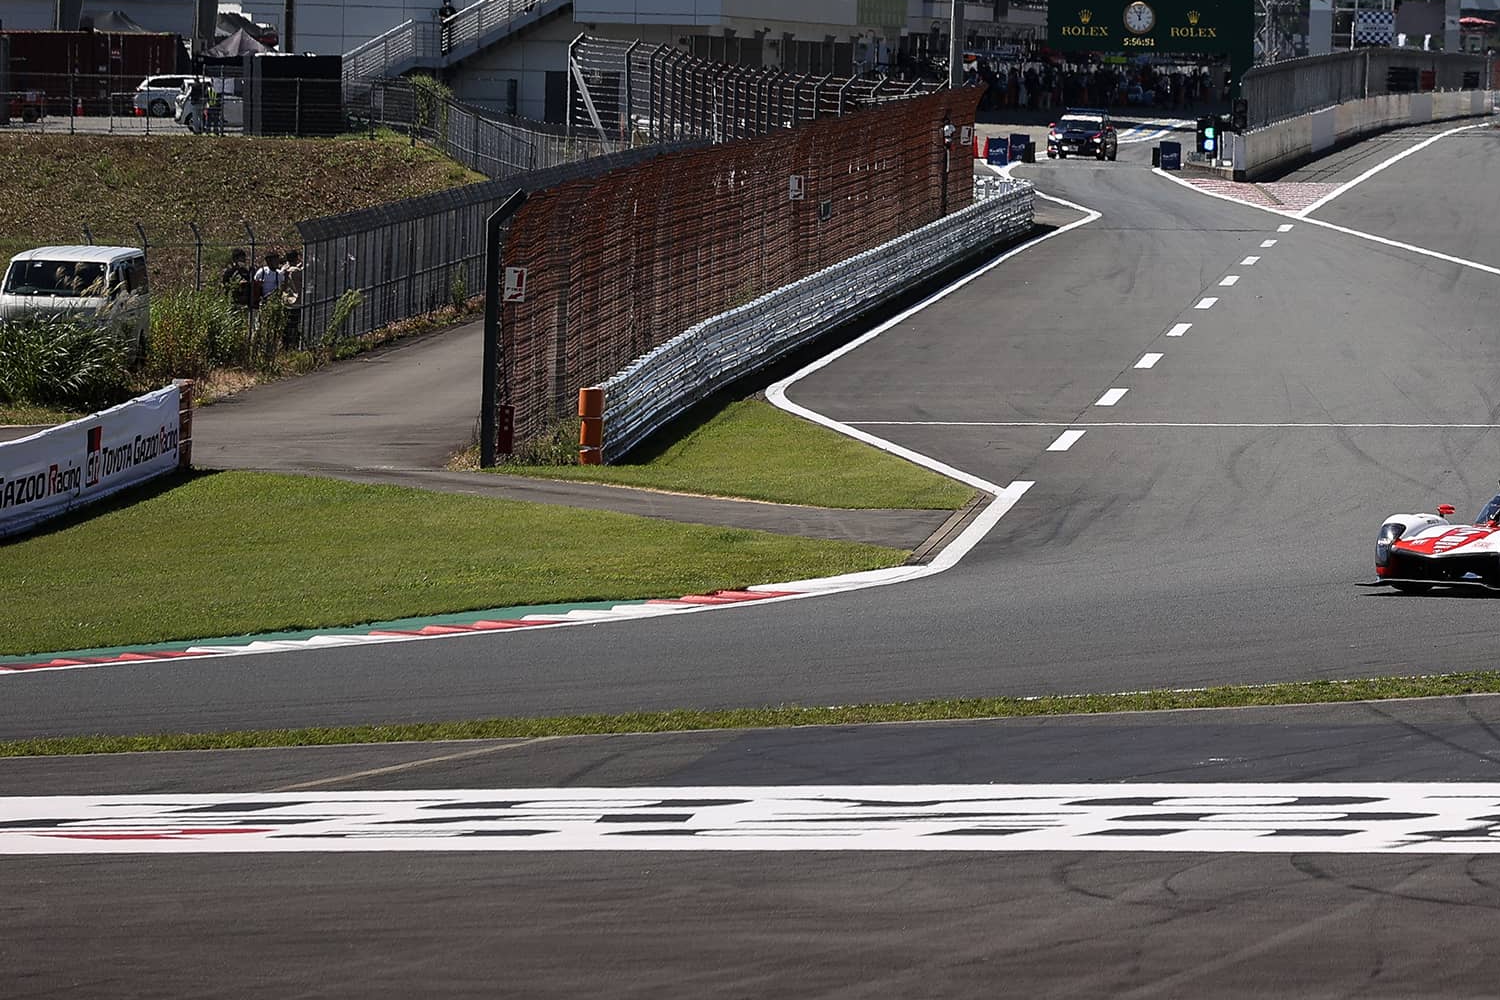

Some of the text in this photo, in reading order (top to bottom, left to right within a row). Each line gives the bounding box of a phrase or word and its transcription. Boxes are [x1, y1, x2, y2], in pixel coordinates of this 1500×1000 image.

[1062, 26, 1109, 37] ROLEX
[1170, 27, 1217, 38] ROLEX
[102, 442, 132, 477] TOYOTA
[133, 434, 158, 465] GAZOO
[159, 423, 178, 460] Racing
[47, 460, 82, 498] Racing
